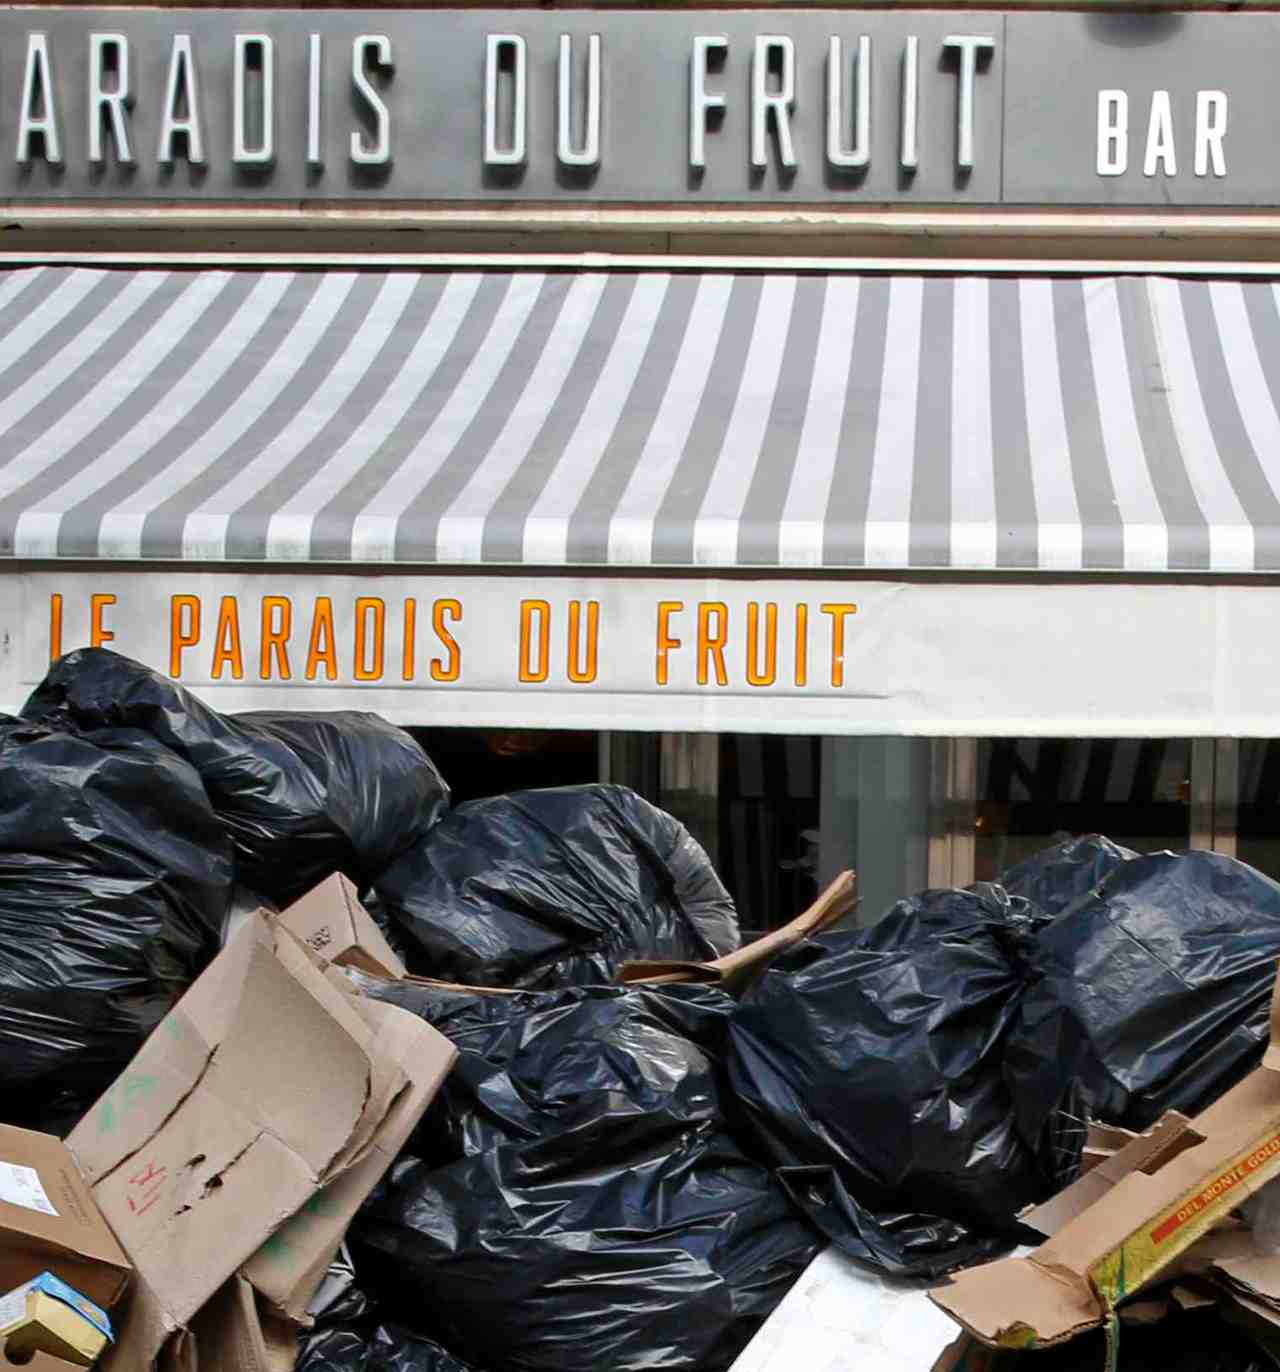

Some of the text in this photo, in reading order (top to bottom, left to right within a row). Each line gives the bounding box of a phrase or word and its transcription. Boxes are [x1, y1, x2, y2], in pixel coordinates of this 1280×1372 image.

[483, 33, 602, 171] DU
[690, 34, 997, 172] FRUIT
[1096, 89, 1229, 179] BAR
[170, 594, 462, 682] PARADIS
[519, 600, 601, 684] DU
[656, 601, 858, 688] FRUIT
[1247, 1140, 1280, 1169] GOLD
